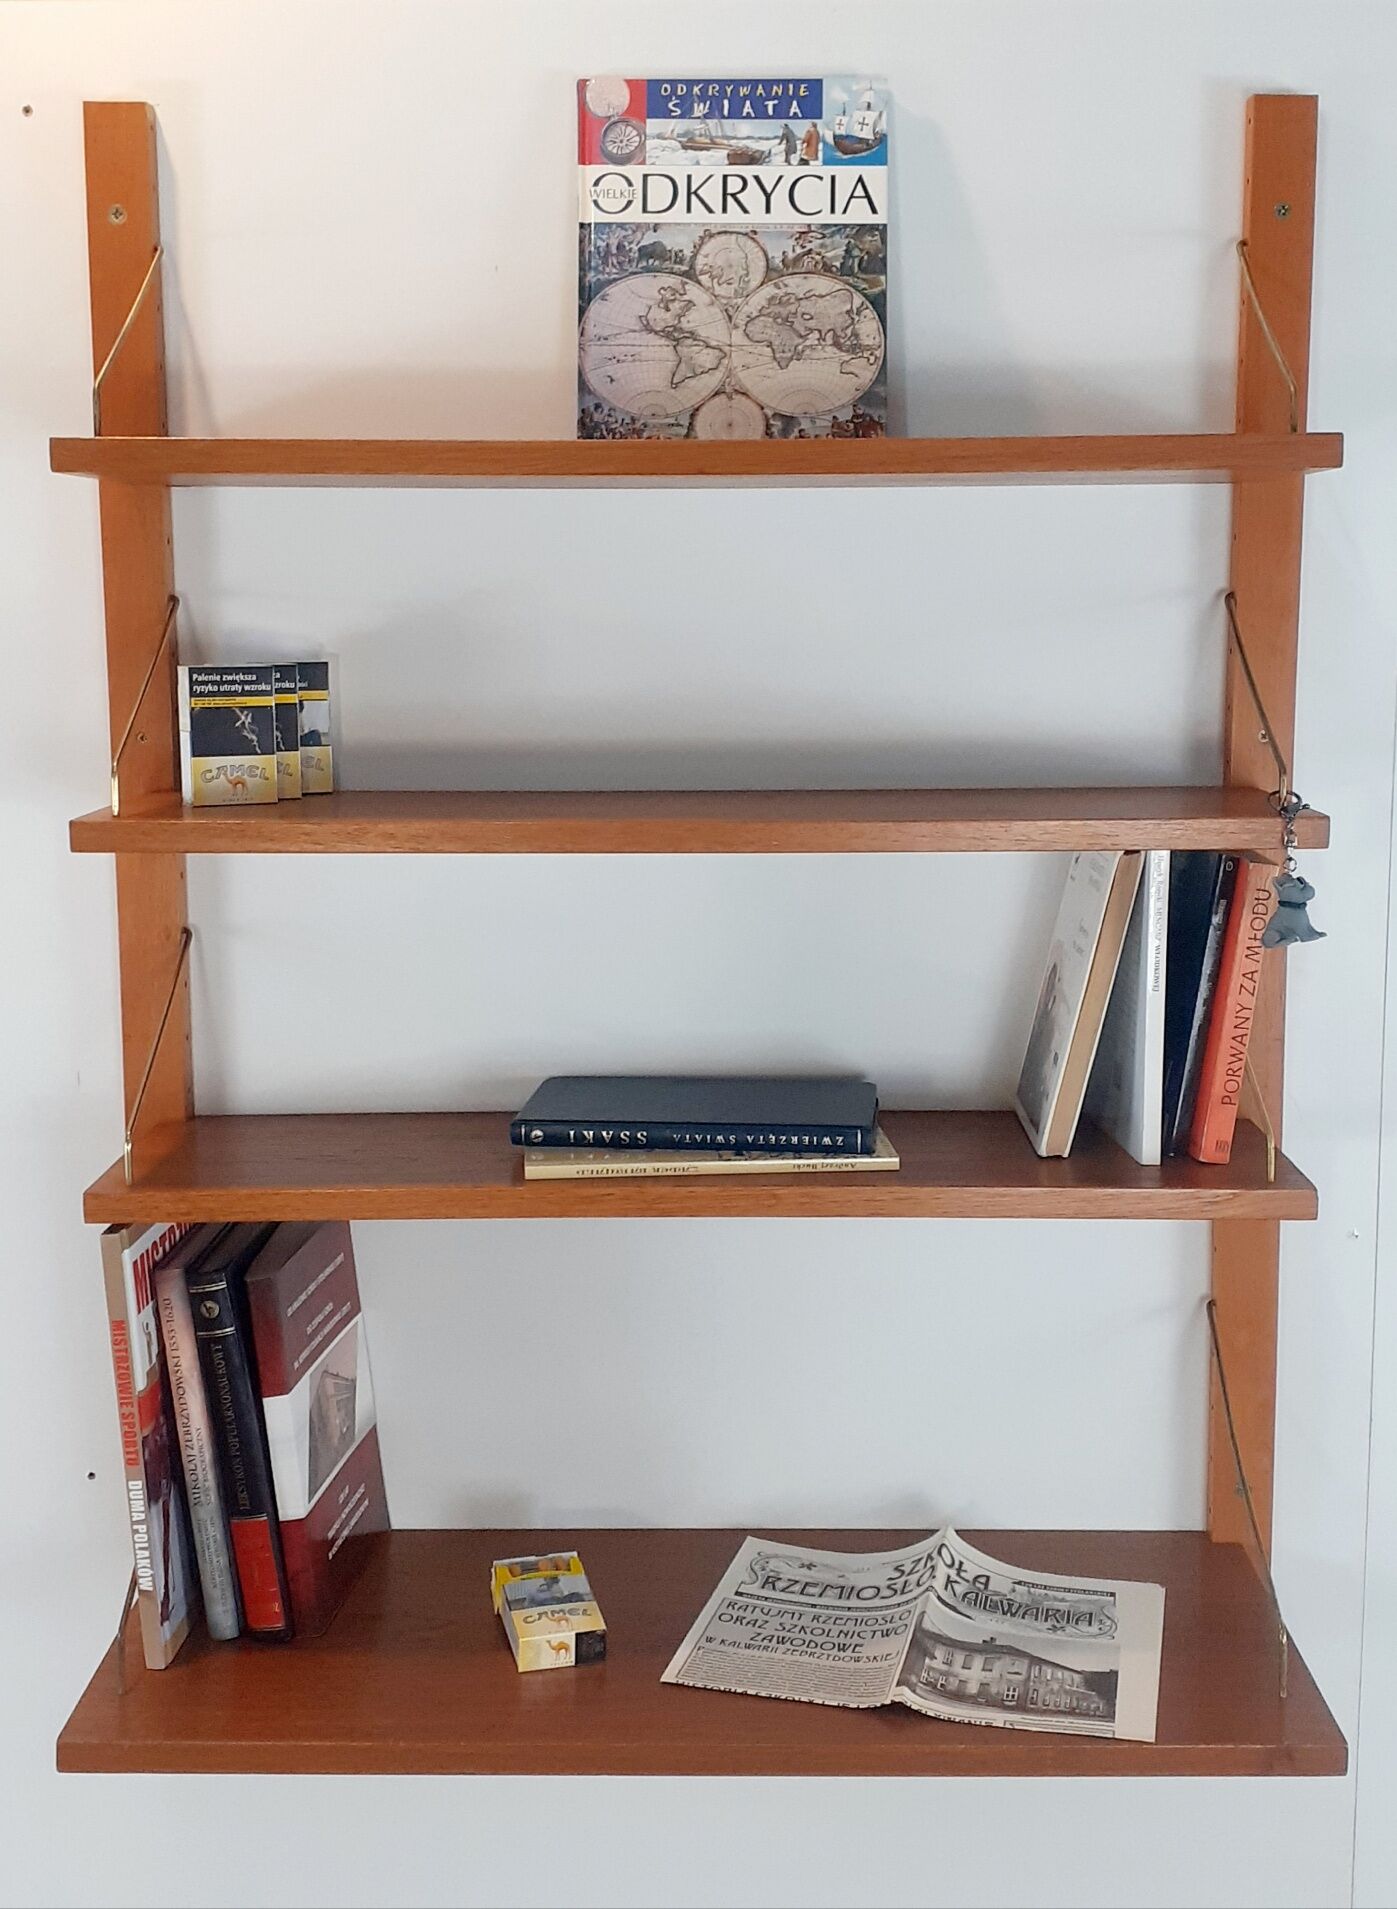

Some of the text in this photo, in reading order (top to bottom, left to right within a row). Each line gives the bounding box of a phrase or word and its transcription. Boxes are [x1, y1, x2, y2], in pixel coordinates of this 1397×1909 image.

[660, 83, 809, 98] ODKRYWANIE
[667, 98, 802, 118] ŚWIATA
[589, 187, 637, 200] WIELKIE
[591, 171, 879, 216] ODKRYCIA
[192, 672, 257, 685] Palenie zwiększa
[193, 682, 272, 694] ryzyko utraty wzroku
[200, 764, 269, 784] CAMEL
[1221, 888, 1272, 1106] PORWANY ZA MŁODU
[567, 1130, 844, 1147] ZWIERZĘTA ŚWIATA SSAKI
[111, 1319, 154, 1591] MISTRZOWIE SPORTU DUMA POLAKÓW
[522, 1607, 592, 1625] CAMEL
[718, 1612, 908, 1642] ORAZ SZKOLNICTWO
[750, 1631, 865, 1654] ZAWODOWE
